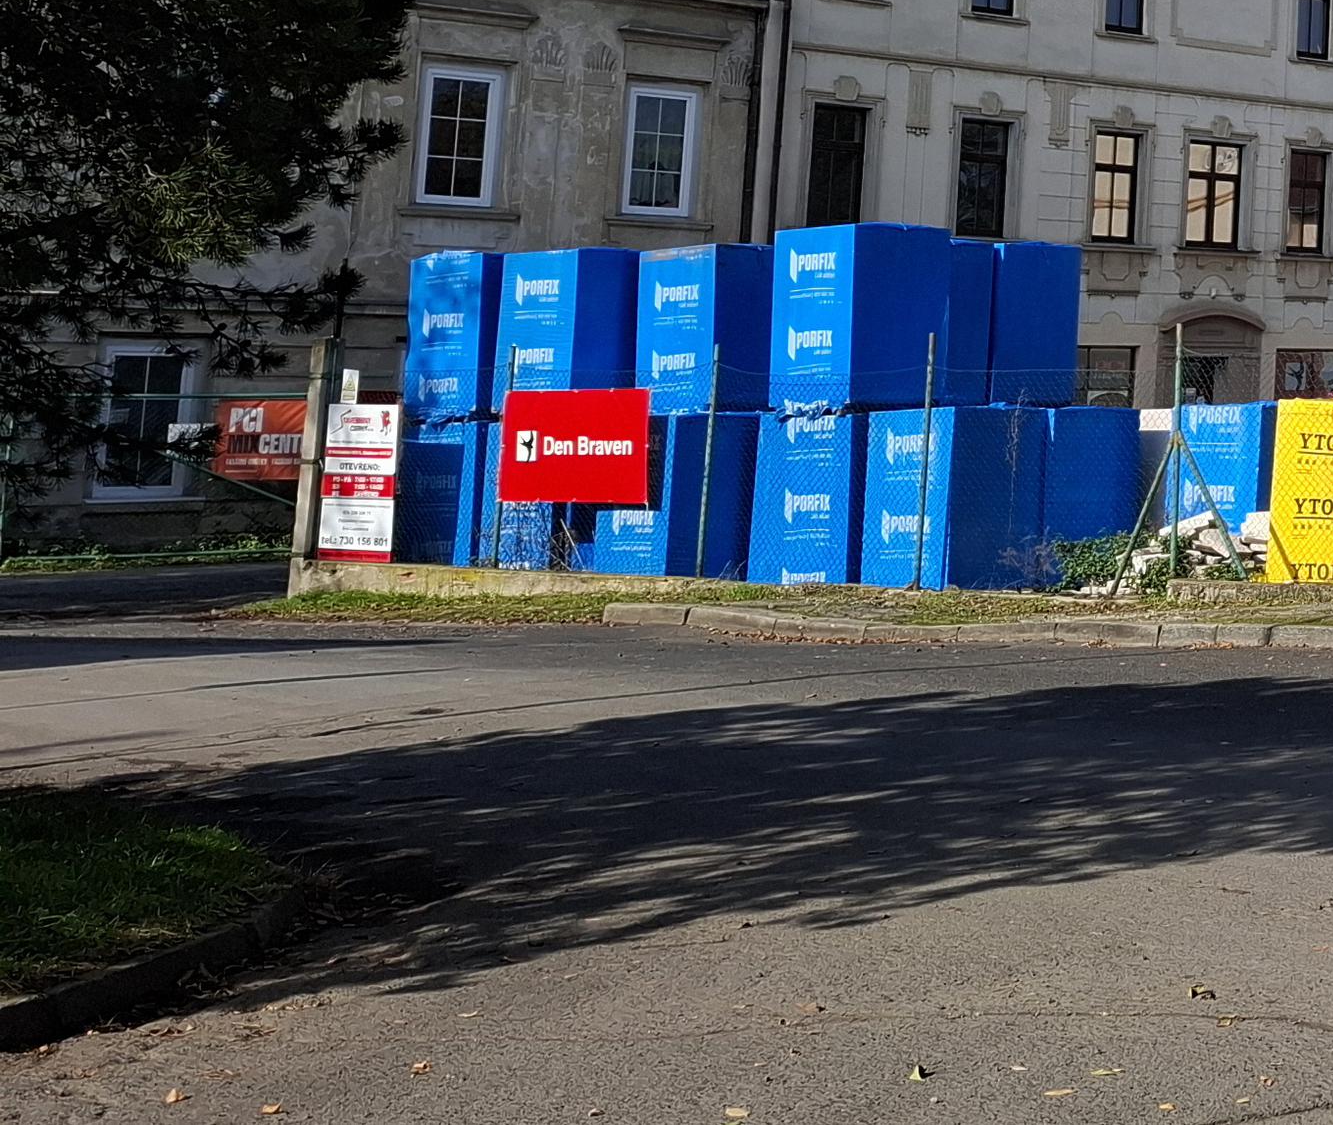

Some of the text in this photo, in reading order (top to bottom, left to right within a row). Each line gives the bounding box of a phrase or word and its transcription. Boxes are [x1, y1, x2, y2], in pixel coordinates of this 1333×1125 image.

[798, 251, 837, 272] PORFIX
[524, 280, 560, 296] PORFIX
[662, 284, 700, 303] PORFIX
[430, 313, 465, 328] PORFIX
[796, 329, 833, 350] PORFIX
[520, 348, 555, 364] PORFIX
[660, 352, 696, 372] PORFIX
[228, 407, 264, 432] PCI
[543, 435, 573, 456] Den
[577, 435, 633, 456] Braven
[895, 433, 937, 453] PORFX
[793, 493, 831, 513] PORFIX
[890, 514, 931, 533] PORFX
[340, 536, 354, 545] 730
[373, 538, 388, 547] 801
